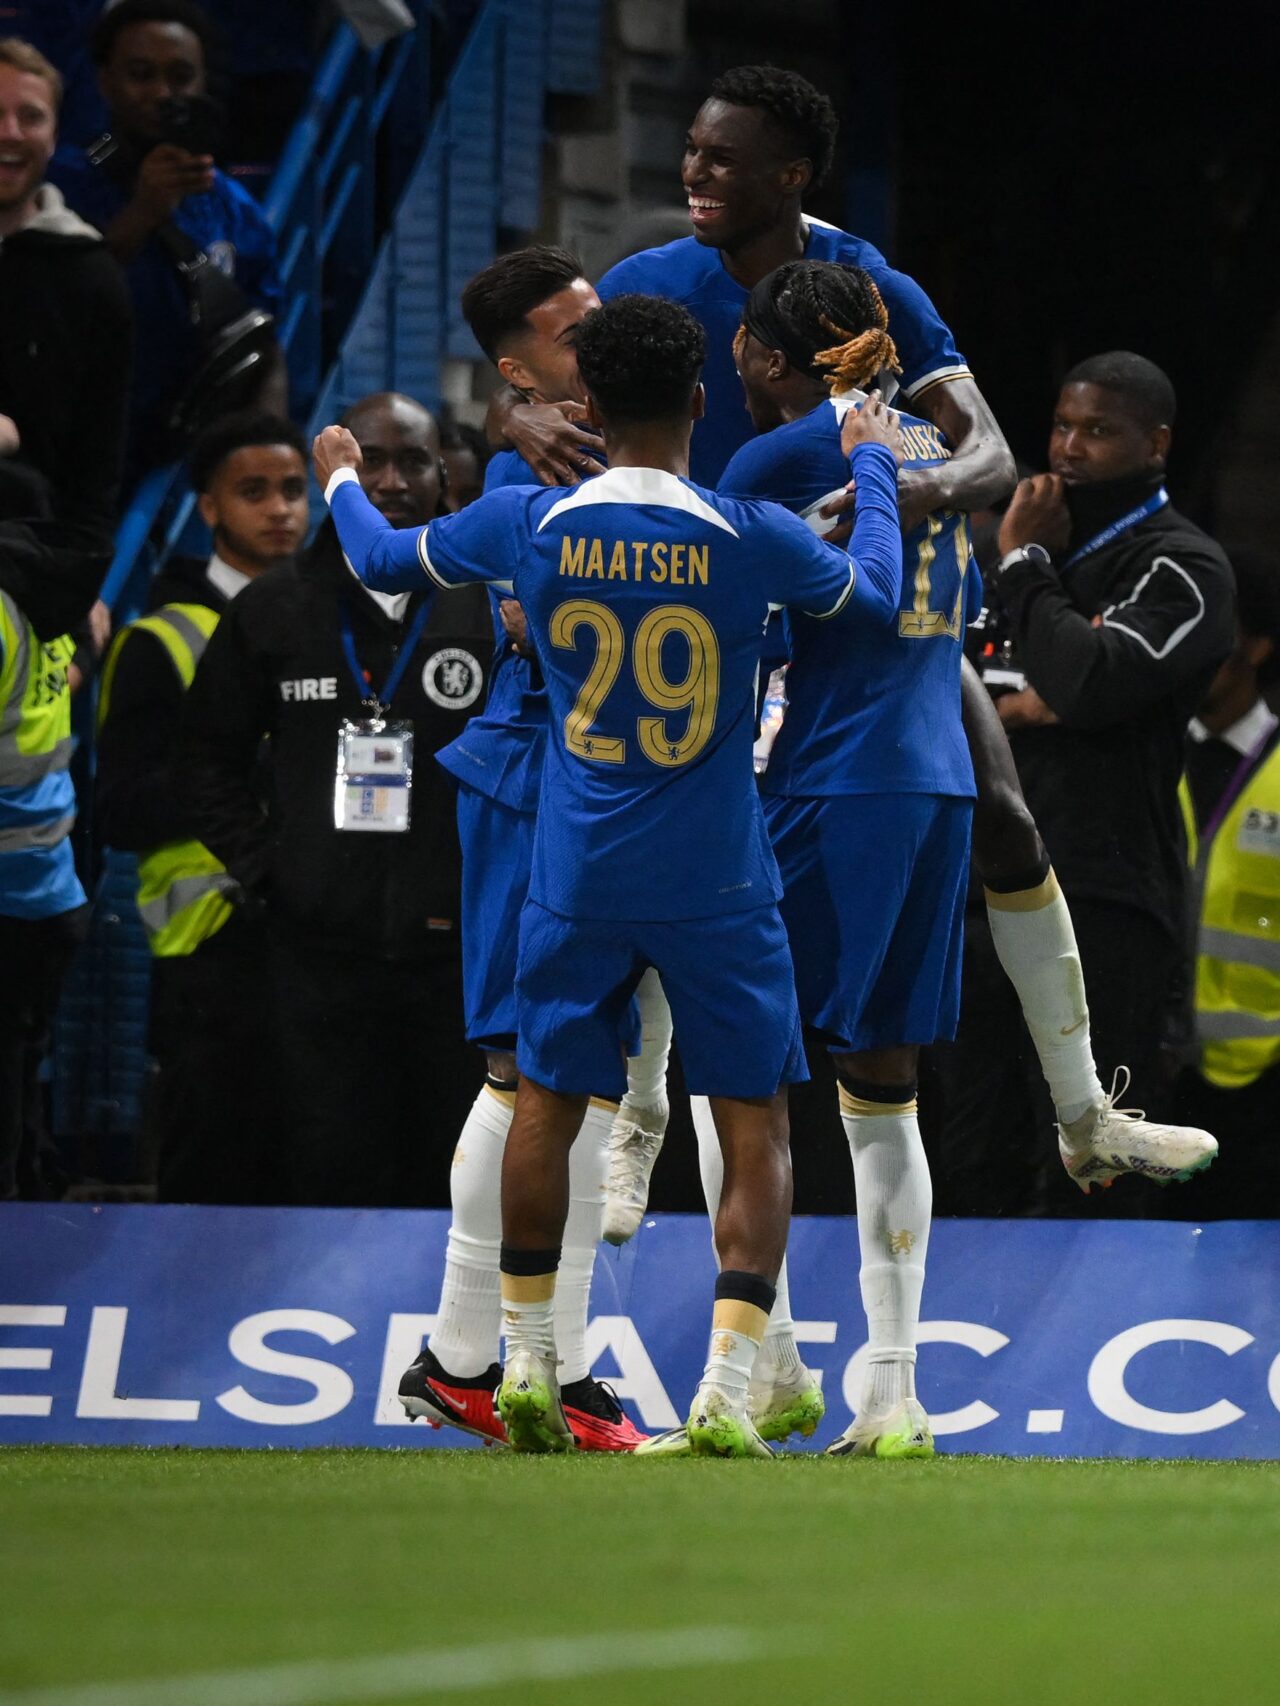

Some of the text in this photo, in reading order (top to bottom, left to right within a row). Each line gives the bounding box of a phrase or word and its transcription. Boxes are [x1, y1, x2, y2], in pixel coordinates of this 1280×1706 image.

[559, 536, 709, 585] MAATSEN
[280, 677, 338, 702] FIRE
[549, 599, 720, 768] 29
